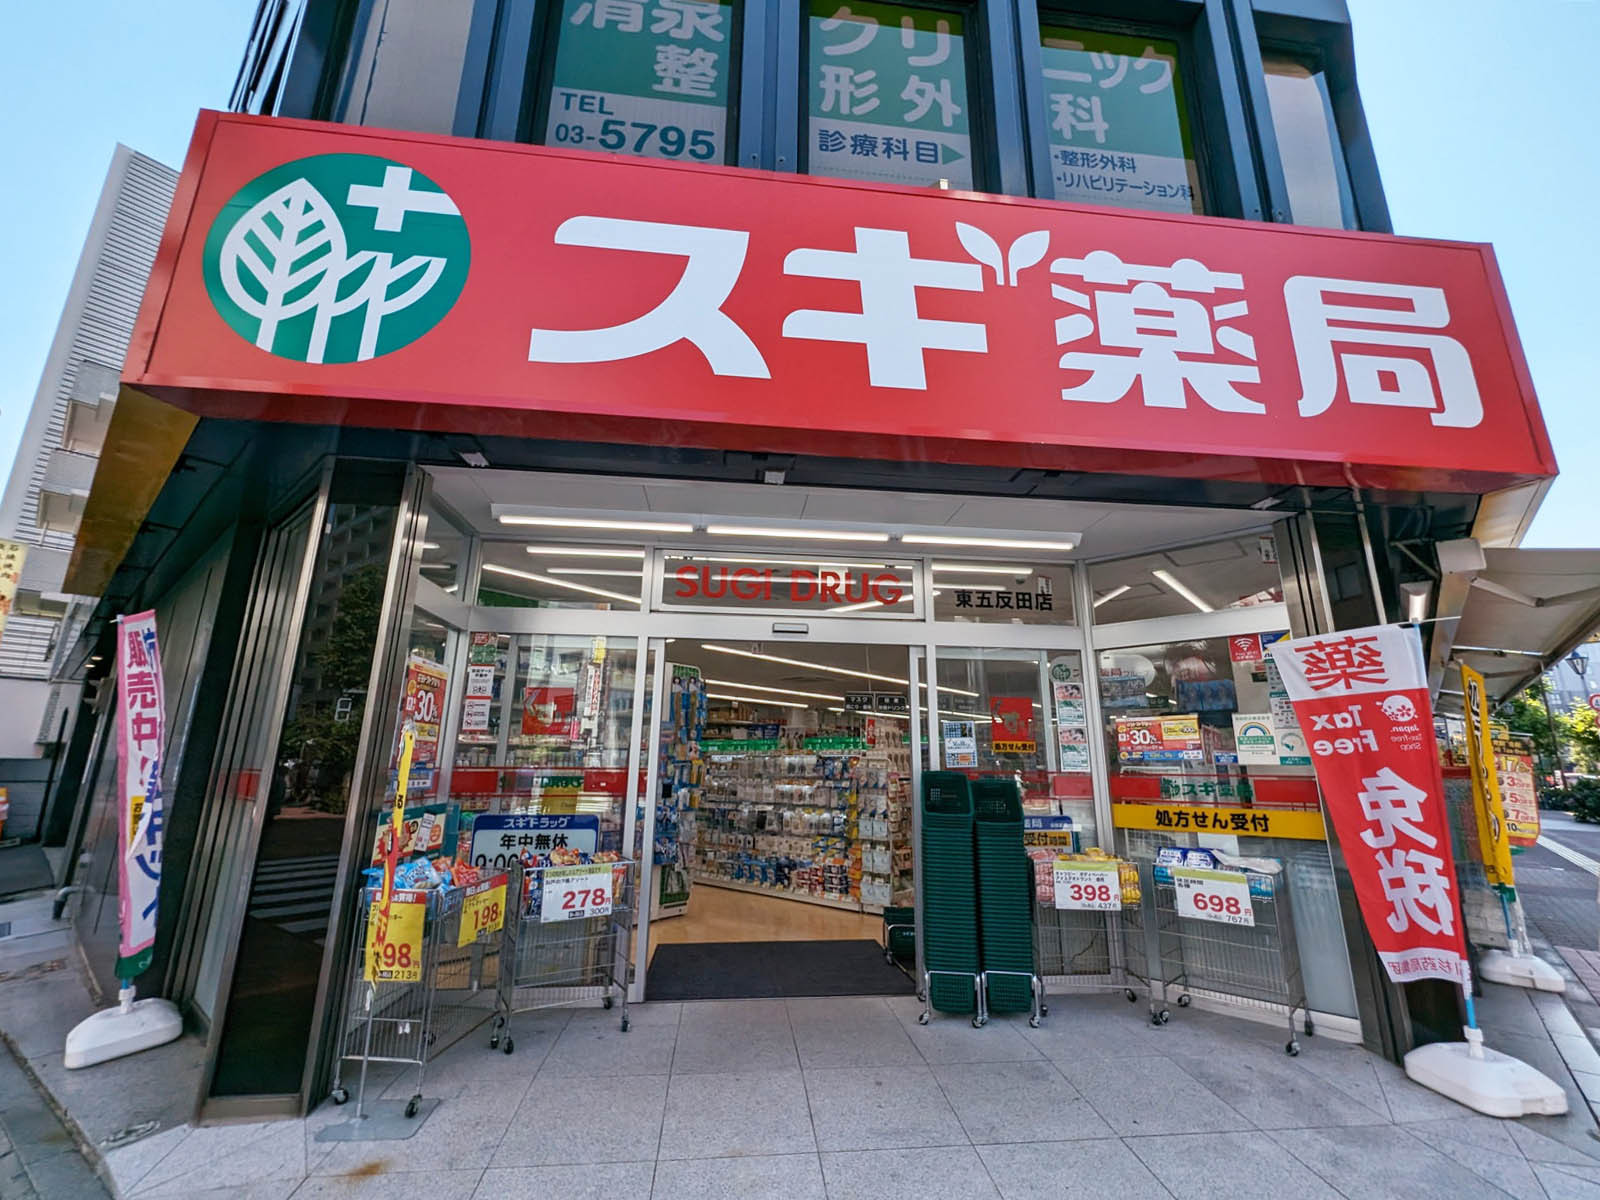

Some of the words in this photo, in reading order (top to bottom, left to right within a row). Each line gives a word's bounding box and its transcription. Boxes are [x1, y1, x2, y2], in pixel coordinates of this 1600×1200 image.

[560, 92, 614, 116] TEL
[555, 119, 716, 160] 03-5795
[818, 129, 939, 164] 診療科目
[528, 214, 1484, 429] スギ薬局
[674, 565, 772, 601] SUGI
[790, 569, 903, 605] DRUG
[954, 589, 1053, 611] 東五反田店
[1156, 809, 1270, 833] 処方せん受付
[499, 833, 569, 850] 年中無休
